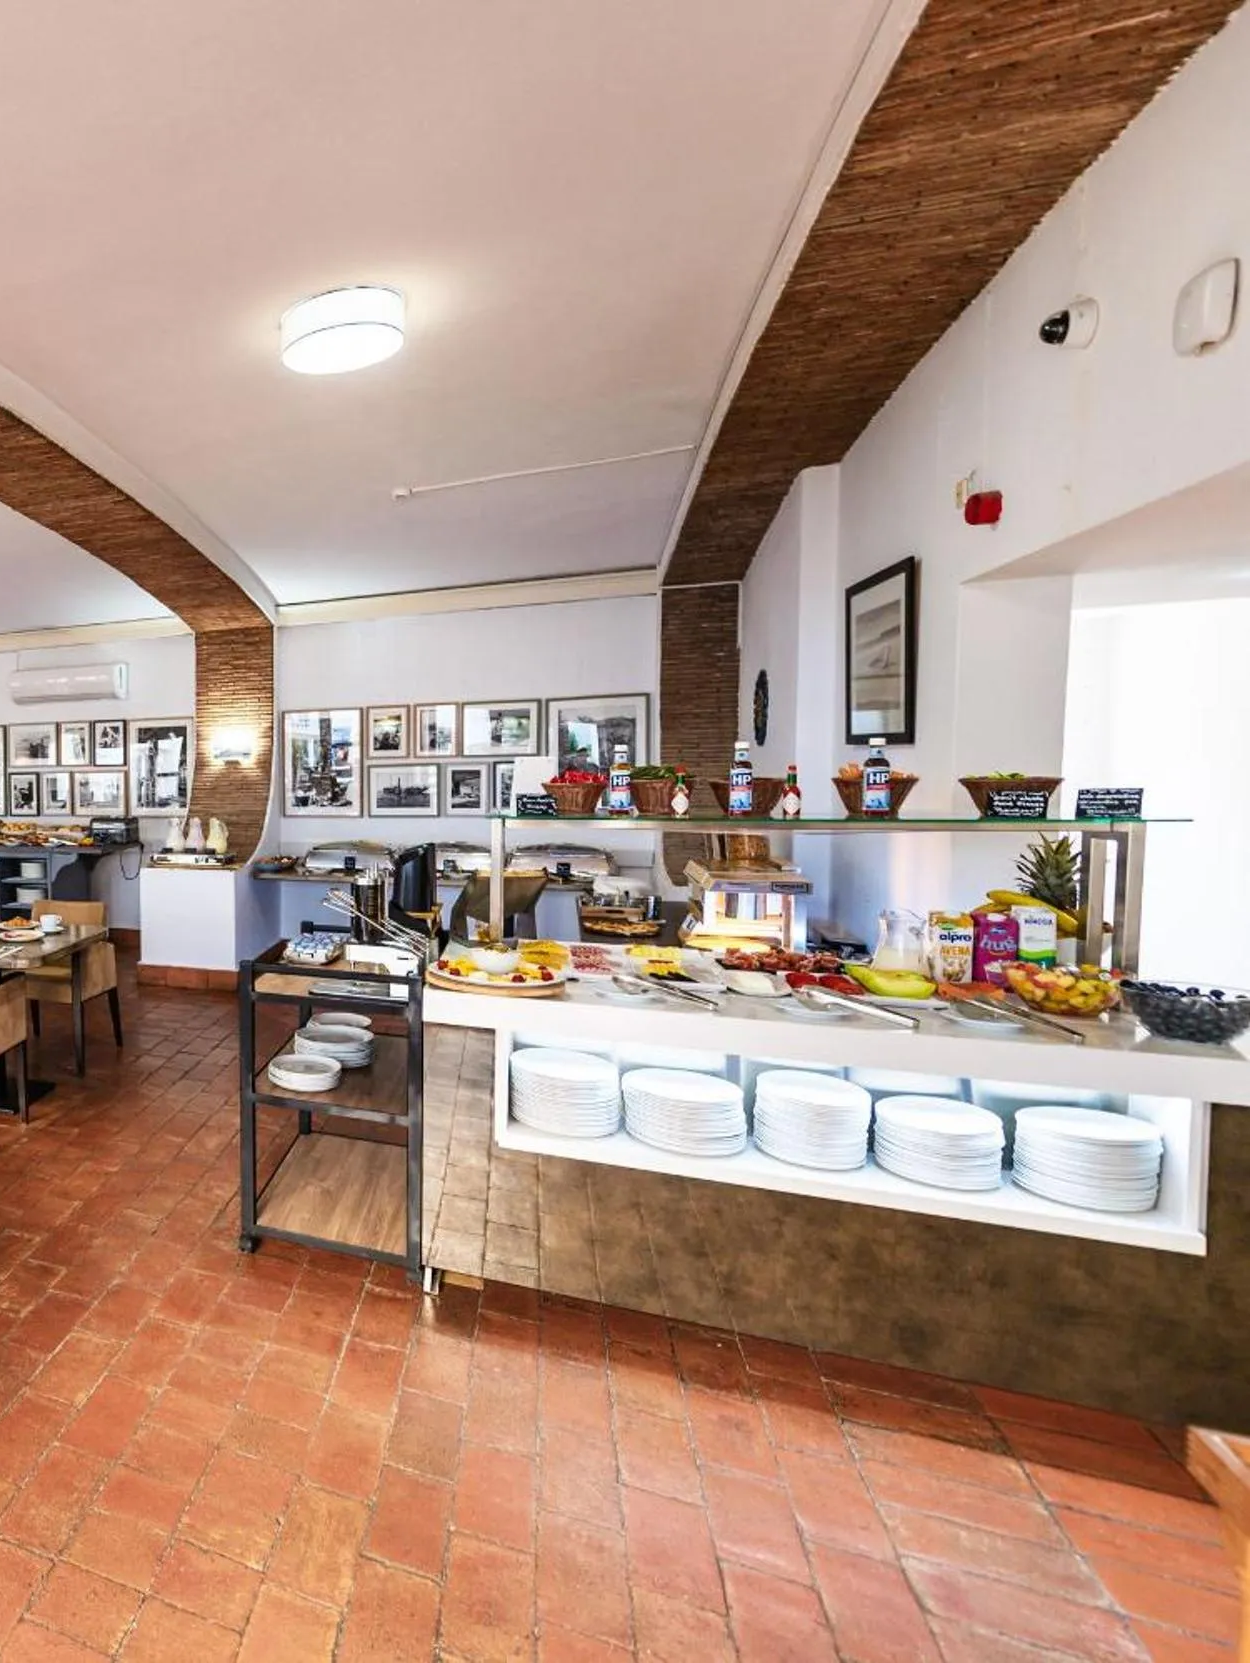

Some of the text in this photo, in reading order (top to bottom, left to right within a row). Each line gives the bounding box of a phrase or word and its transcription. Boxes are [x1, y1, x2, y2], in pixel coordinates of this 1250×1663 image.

[612, 775, 631, 786] HP
[732, 774, 752, 786] HP
[869, 772, 890, 784] HP
[939, 932, 972, 943] alpro
